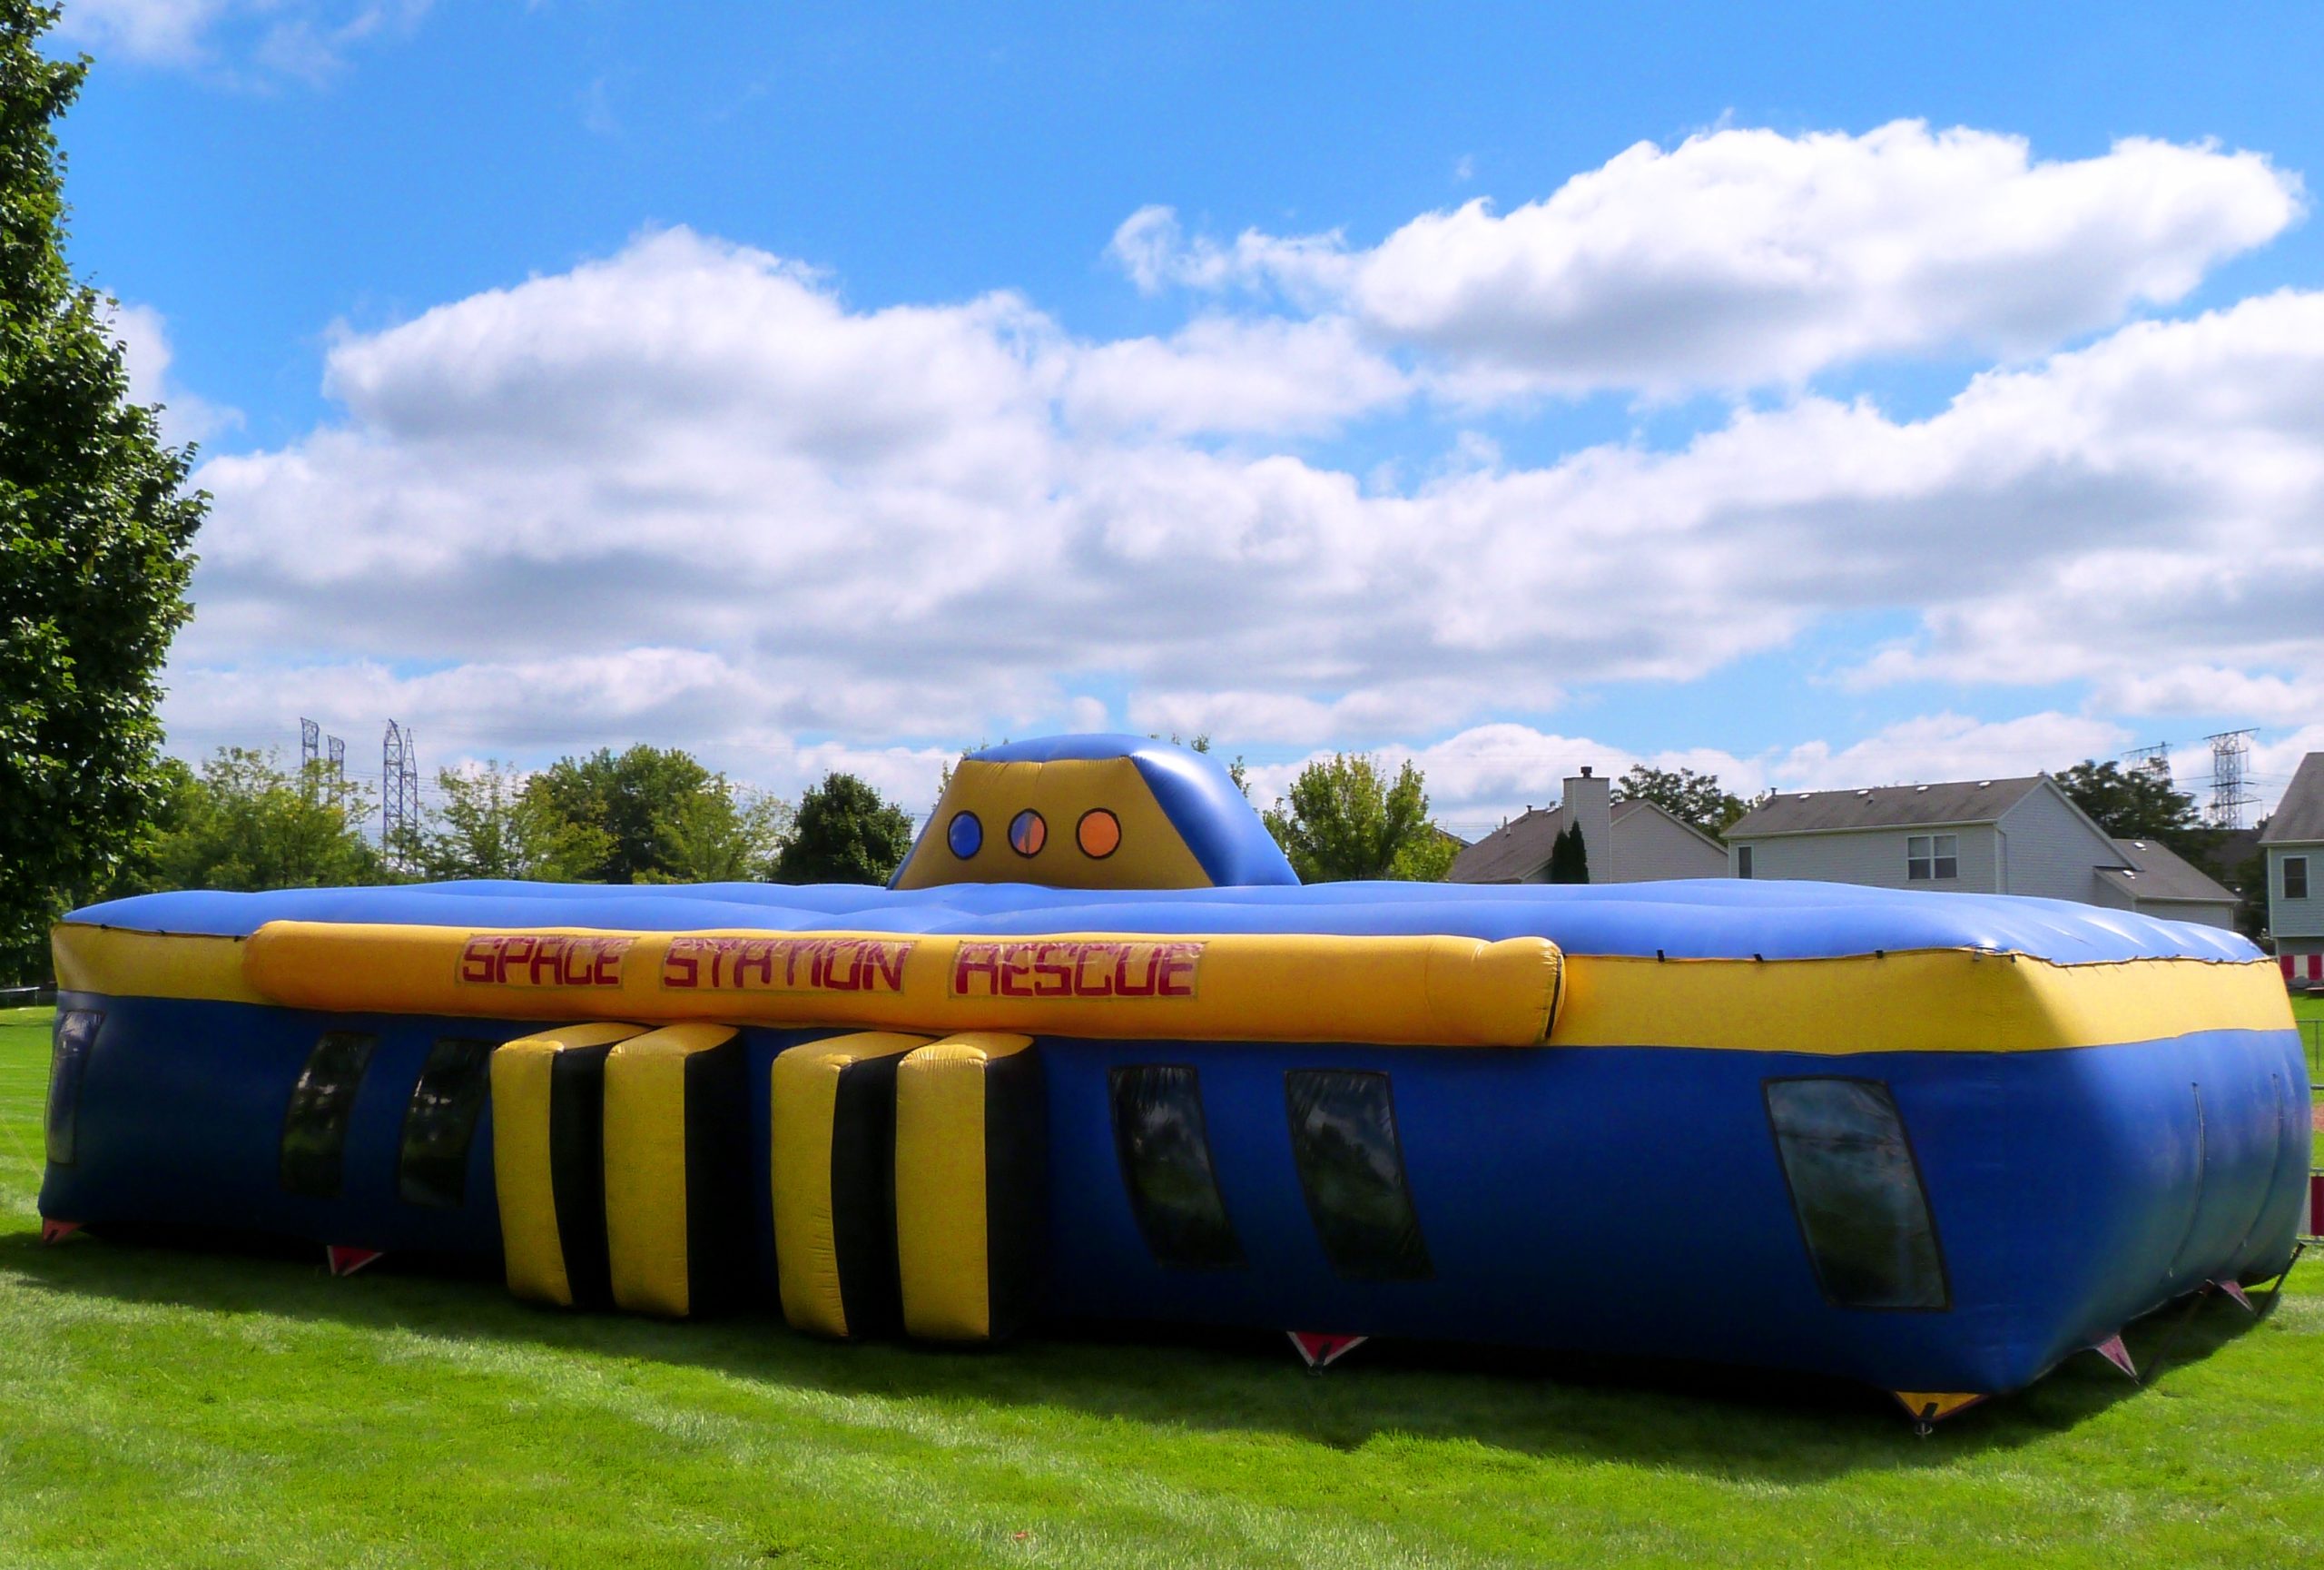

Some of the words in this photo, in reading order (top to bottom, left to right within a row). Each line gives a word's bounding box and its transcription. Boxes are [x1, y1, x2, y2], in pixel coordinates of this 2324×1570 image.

[463, 937, 632, 985] SPACE
[664, 939, 911, 991] STATION
[956, 943, 1203, 996] RESCUE
